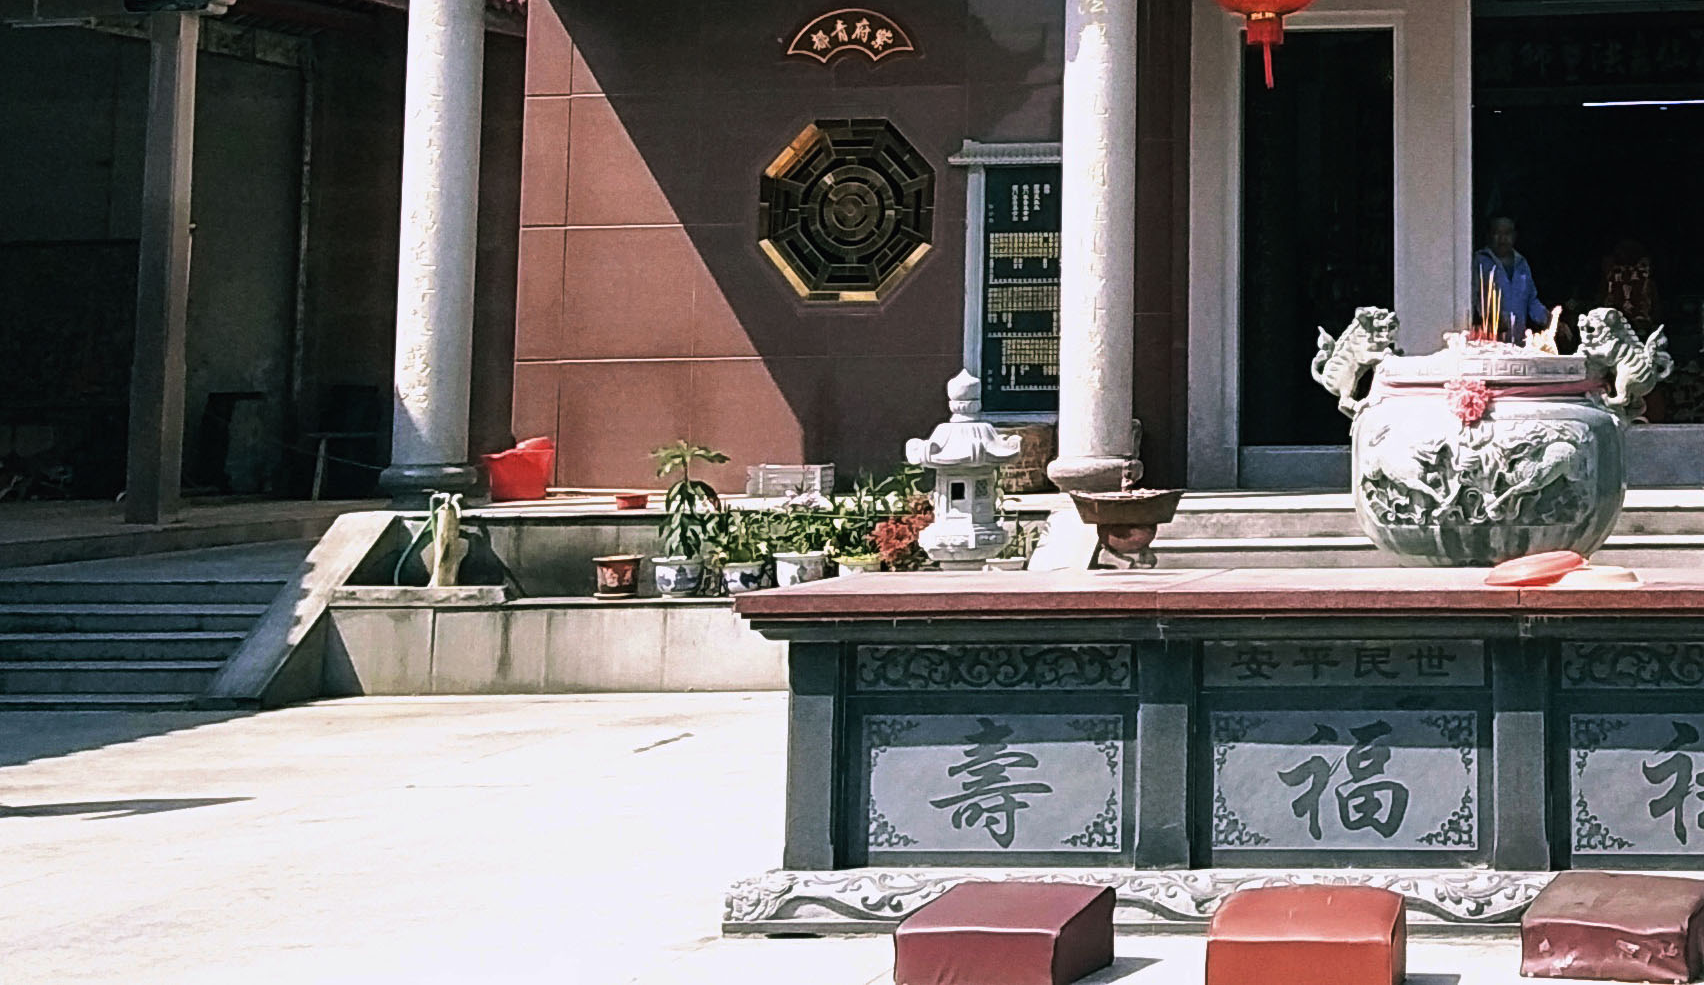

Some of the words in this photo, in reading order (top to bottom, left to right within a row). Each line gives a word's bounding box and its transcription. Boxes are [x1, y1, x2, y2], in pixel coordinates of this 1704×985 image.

[1231, 646, 1456, 679] 世民平安
[930, 717, 1053, 850] 壽
[1277, 719, 1410, 840] 福
